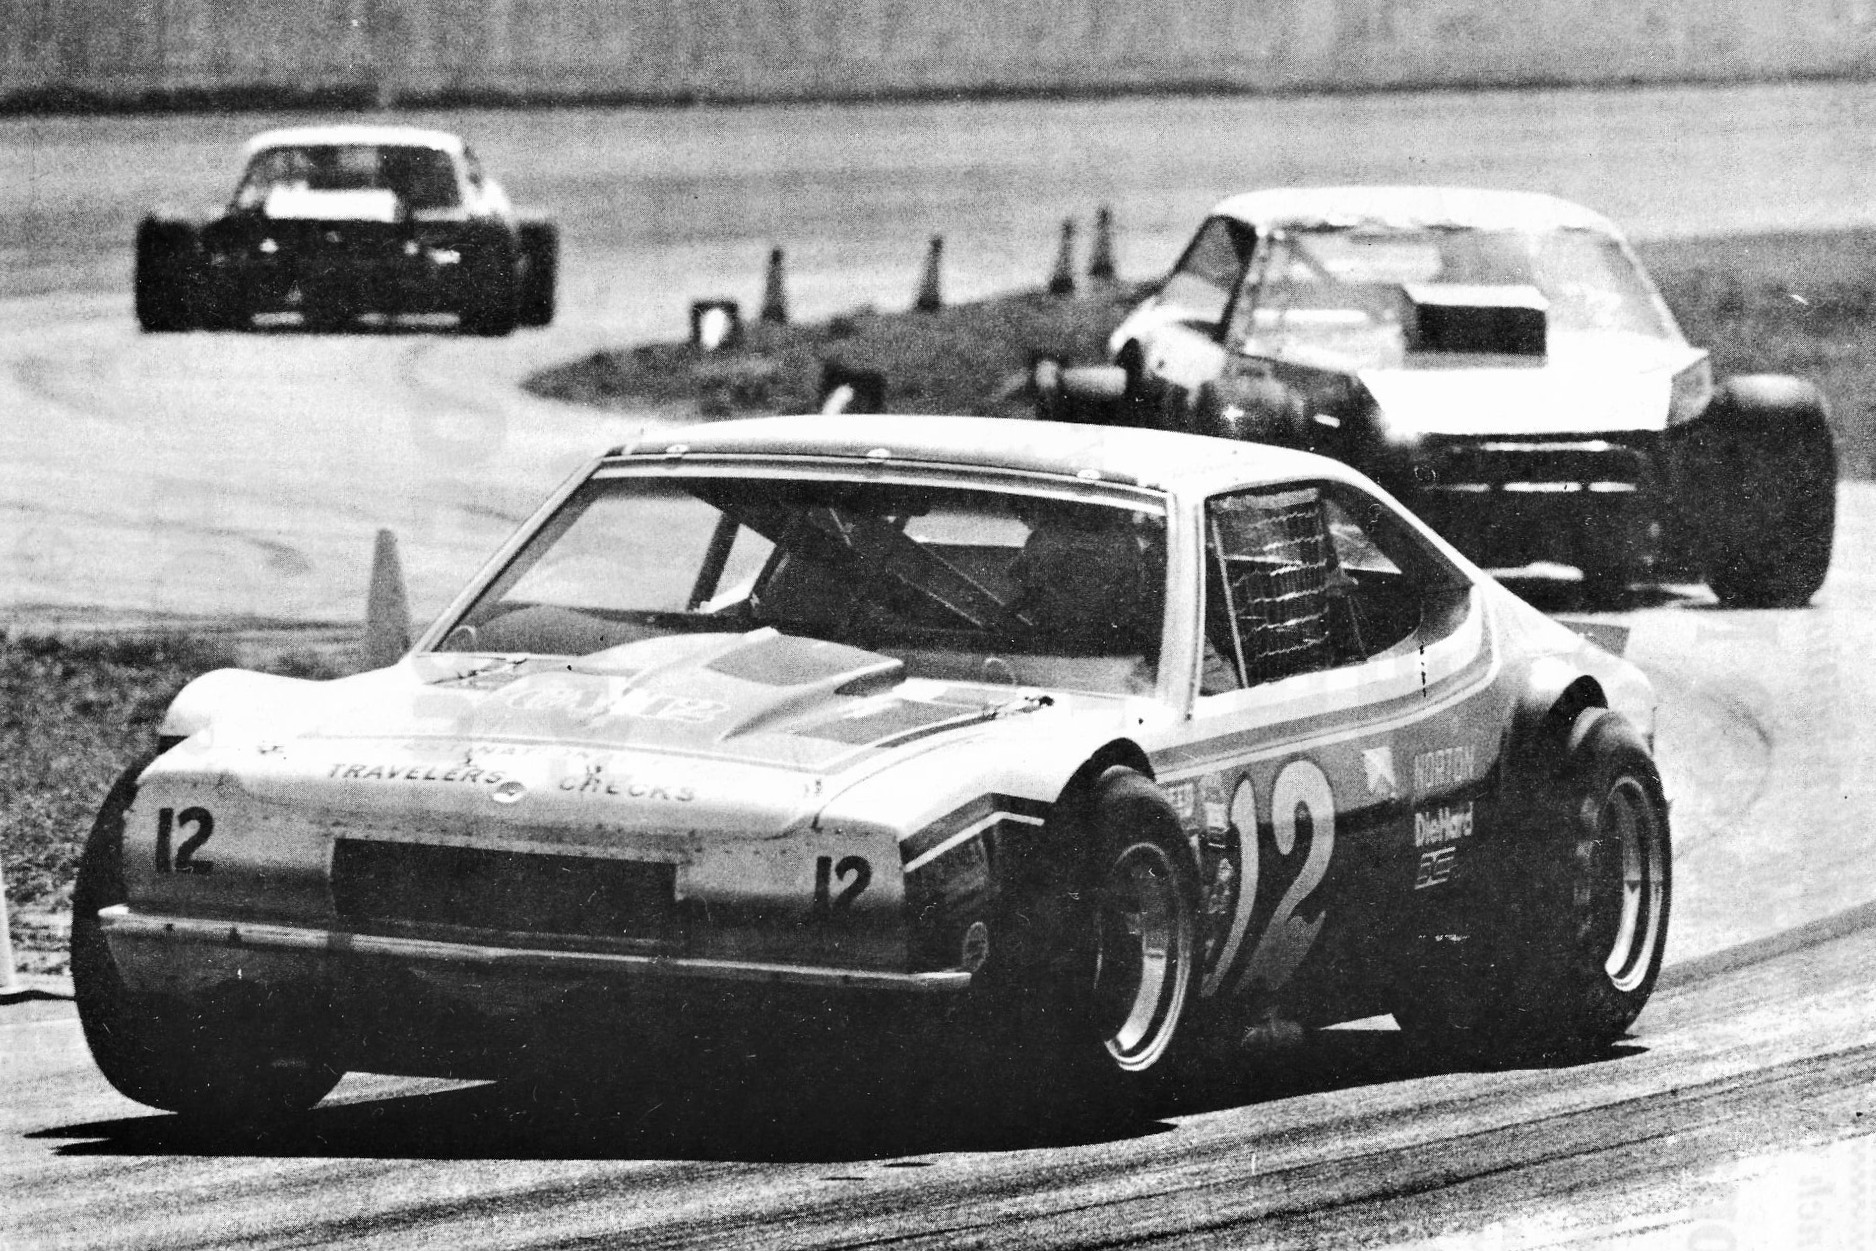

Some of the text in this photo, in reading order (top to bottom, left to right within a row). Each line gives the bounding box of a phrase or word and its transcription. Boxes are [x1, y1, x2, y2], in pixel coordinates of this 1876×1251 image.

[328, 763, 505, 785] TRAVELERS
[558, 773, 696, 802] CHECKS
[156, 806, 215, 875] 12
[1414, 801, 1474, 846] DieHard
[813, 855, 874, 913] 12
[1200, 759, 1335, 995] 12
